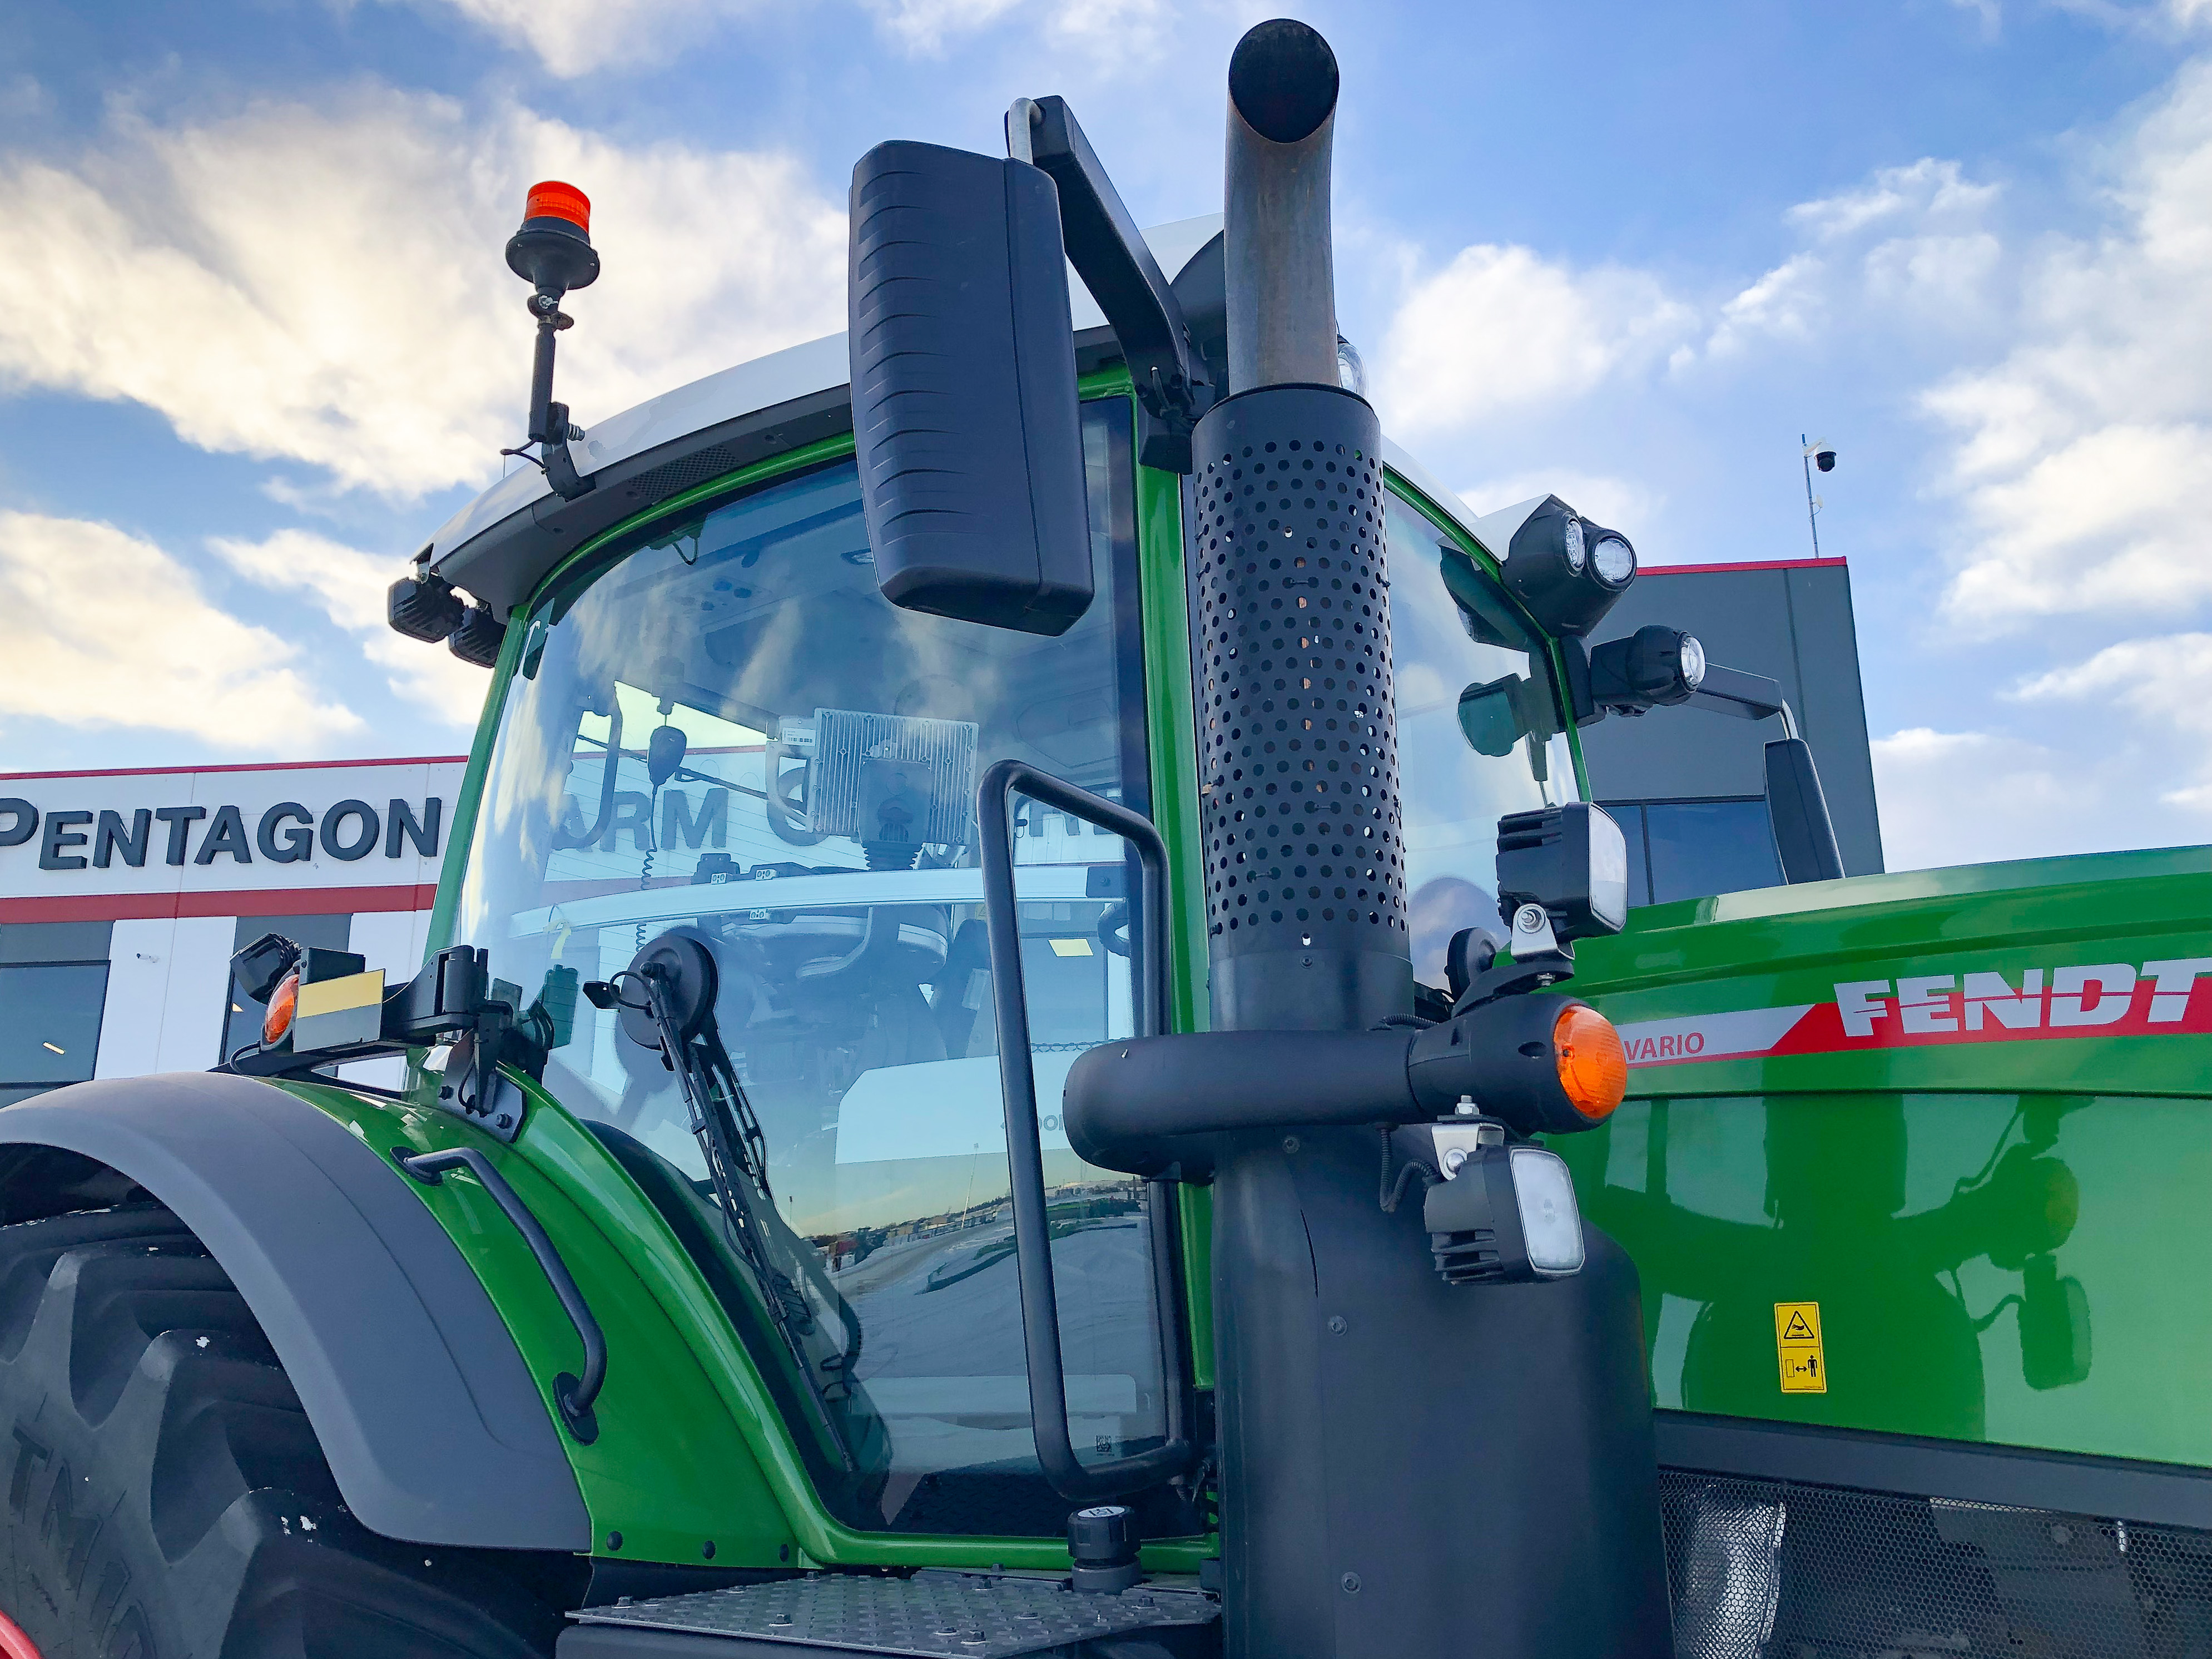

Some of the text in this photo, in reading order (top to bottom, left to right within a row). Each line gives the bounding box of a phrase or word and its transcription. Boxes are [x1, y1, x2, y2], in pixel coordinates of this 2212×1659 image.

[0, 796, 442, 870] PENTAGON
[1833, 957, 2212, 1037] FENDT
[1623, 1032, 1705, 1061] VARIO
